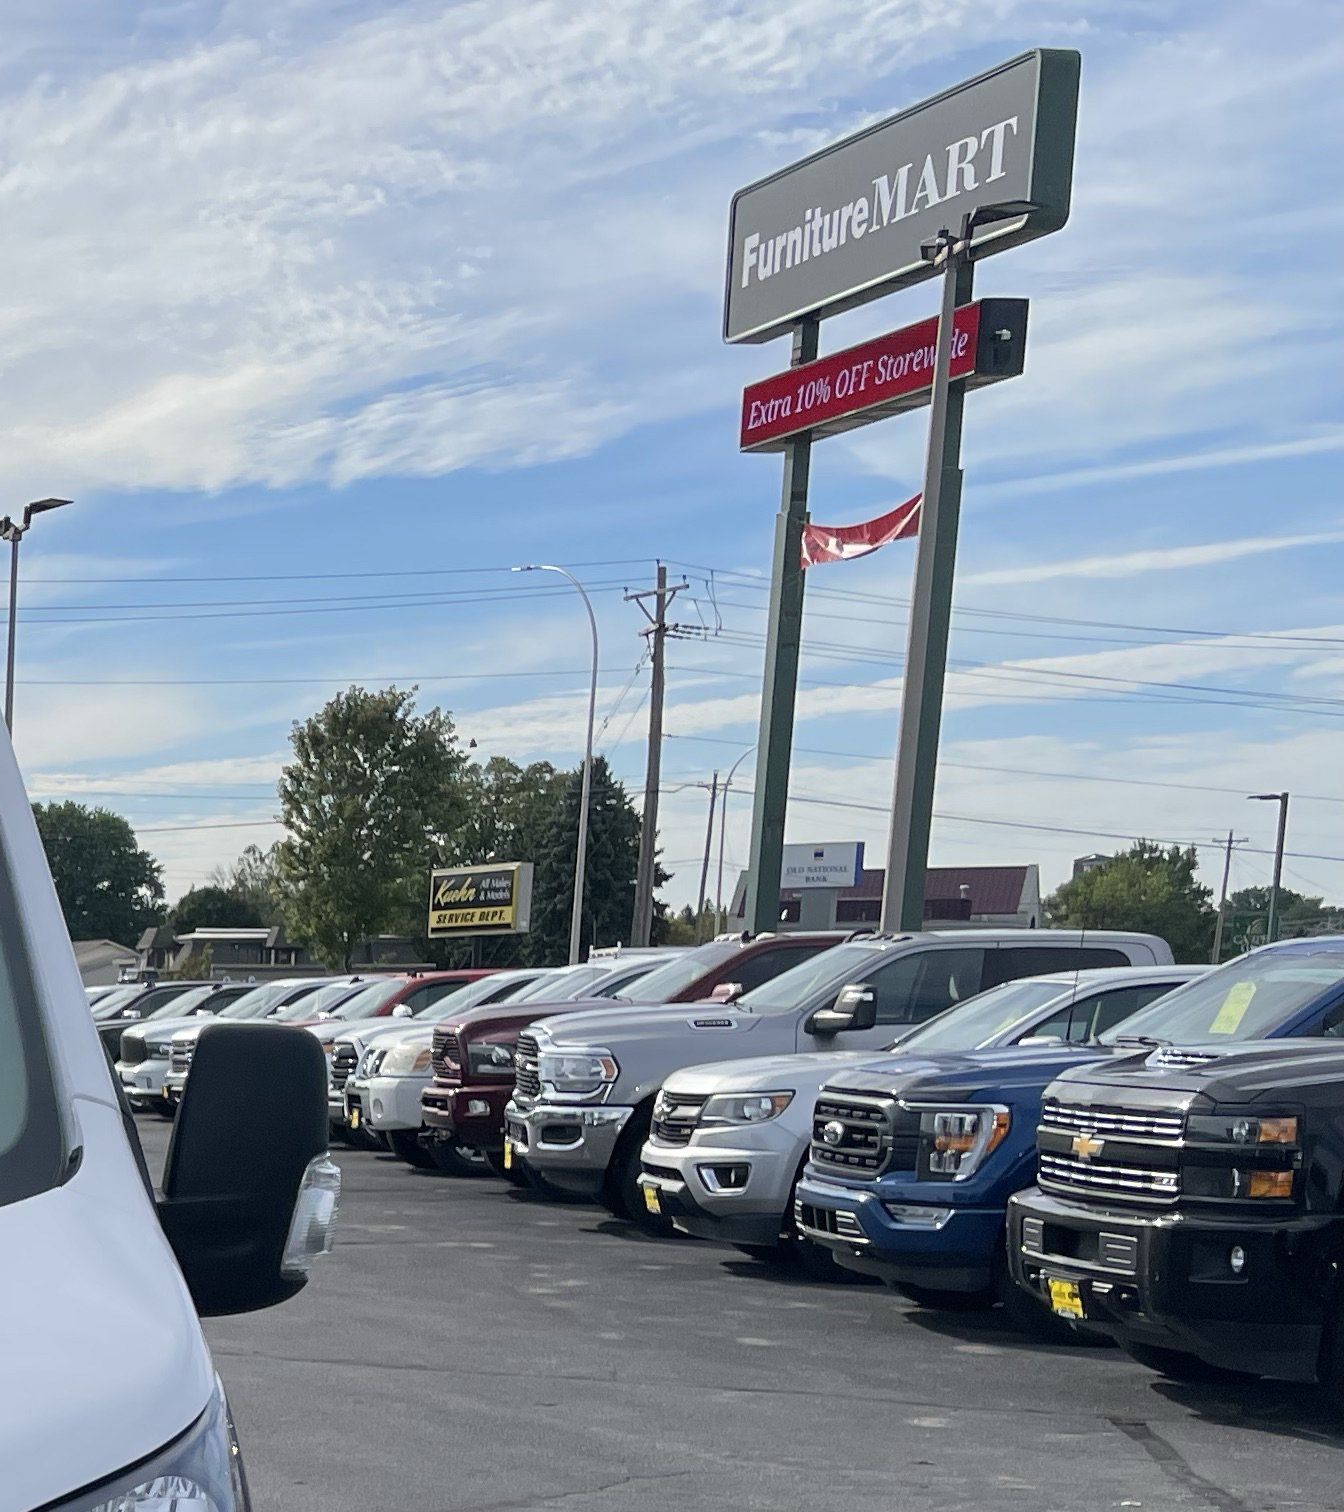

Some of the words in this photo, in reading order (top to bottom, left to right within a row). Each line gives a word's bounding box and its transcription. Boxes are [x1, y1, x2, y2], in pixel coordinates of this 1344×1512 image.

[747, 394, 794, 430] Extra
[795, 375, 831, 414] 10%
[835, 358, 873, 400] OFF
[874, 328, 969, 385] Storewde
[807, 864, 849, 874] NATIONAL
[804, 875, 828, 883] BANK
[434, 876, 477, 907] Kuehn
[436, 911, 477, 925] SERVICE
